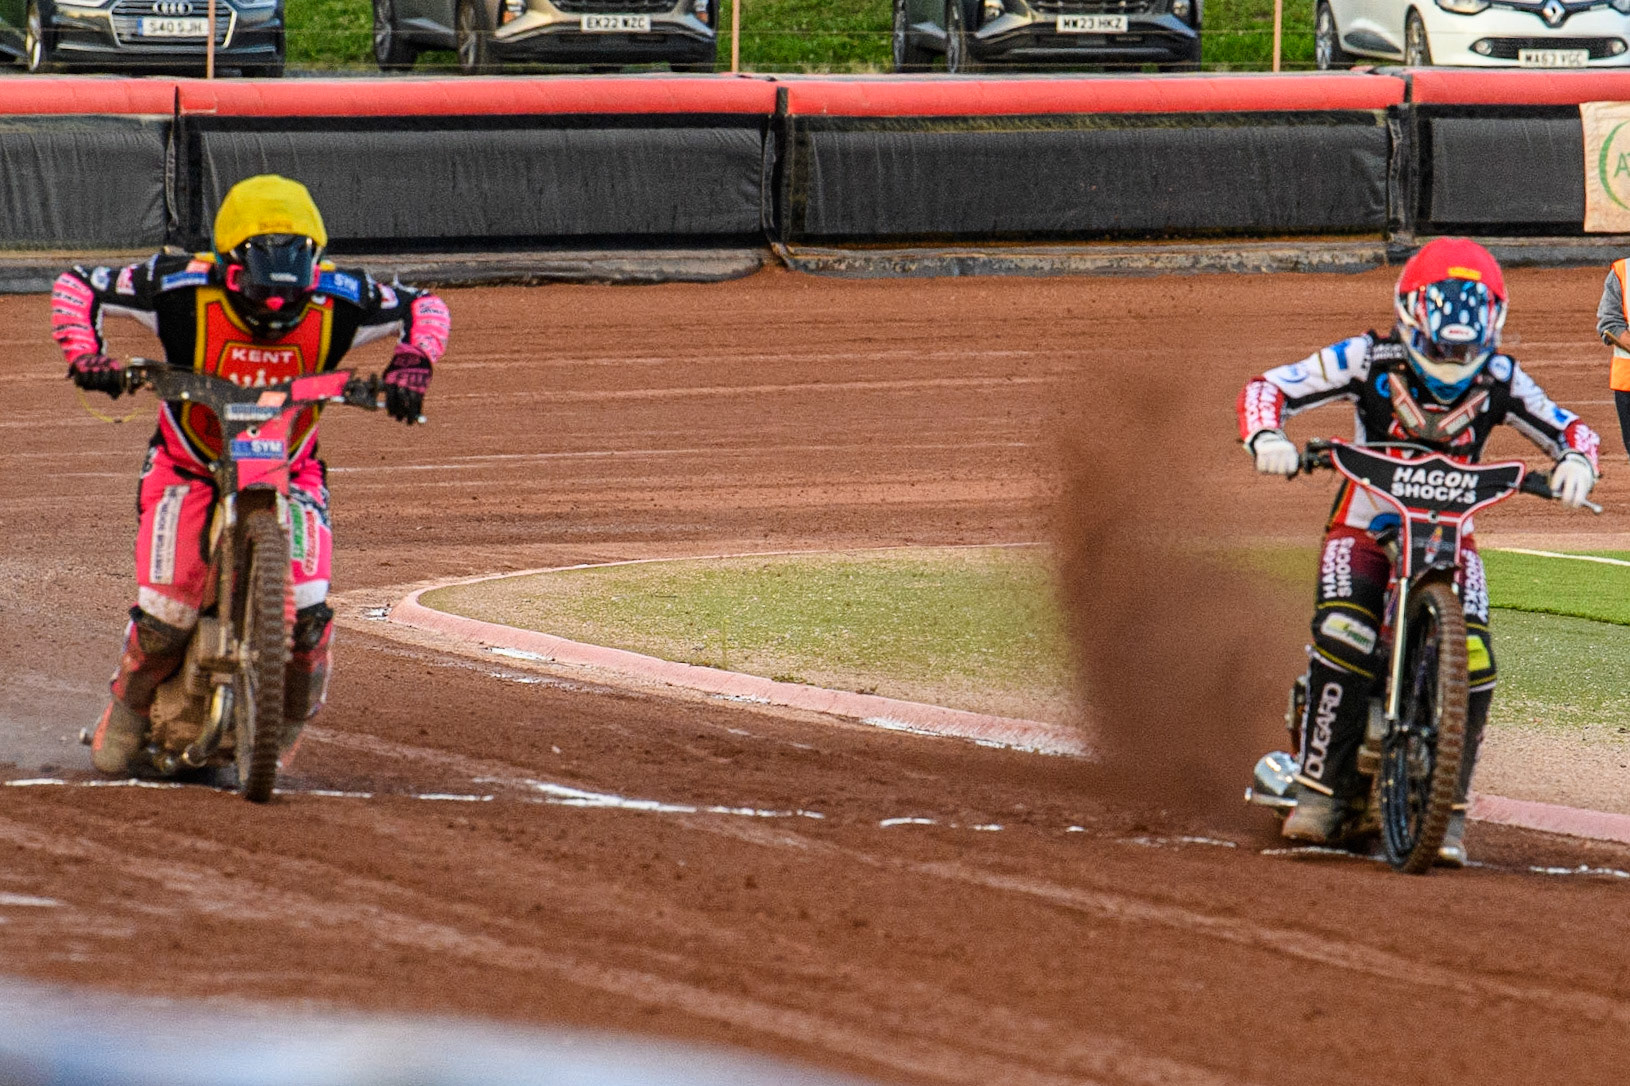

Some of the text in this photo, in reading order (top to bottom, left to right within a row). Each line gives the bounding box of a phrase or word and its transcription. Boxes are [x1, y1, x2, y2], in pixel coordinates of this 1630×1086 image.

[232, 348, 294, 364] KENT
[1391, 482, 1477, 504] SHOCKS
[1393, 467, 1479, 489] HAGON
[1322, 539, 1339, 599] HAGON
[1336, 537, 1355, 597] SHOCKS
[1305, 683, 1343, 780] DUGARD
